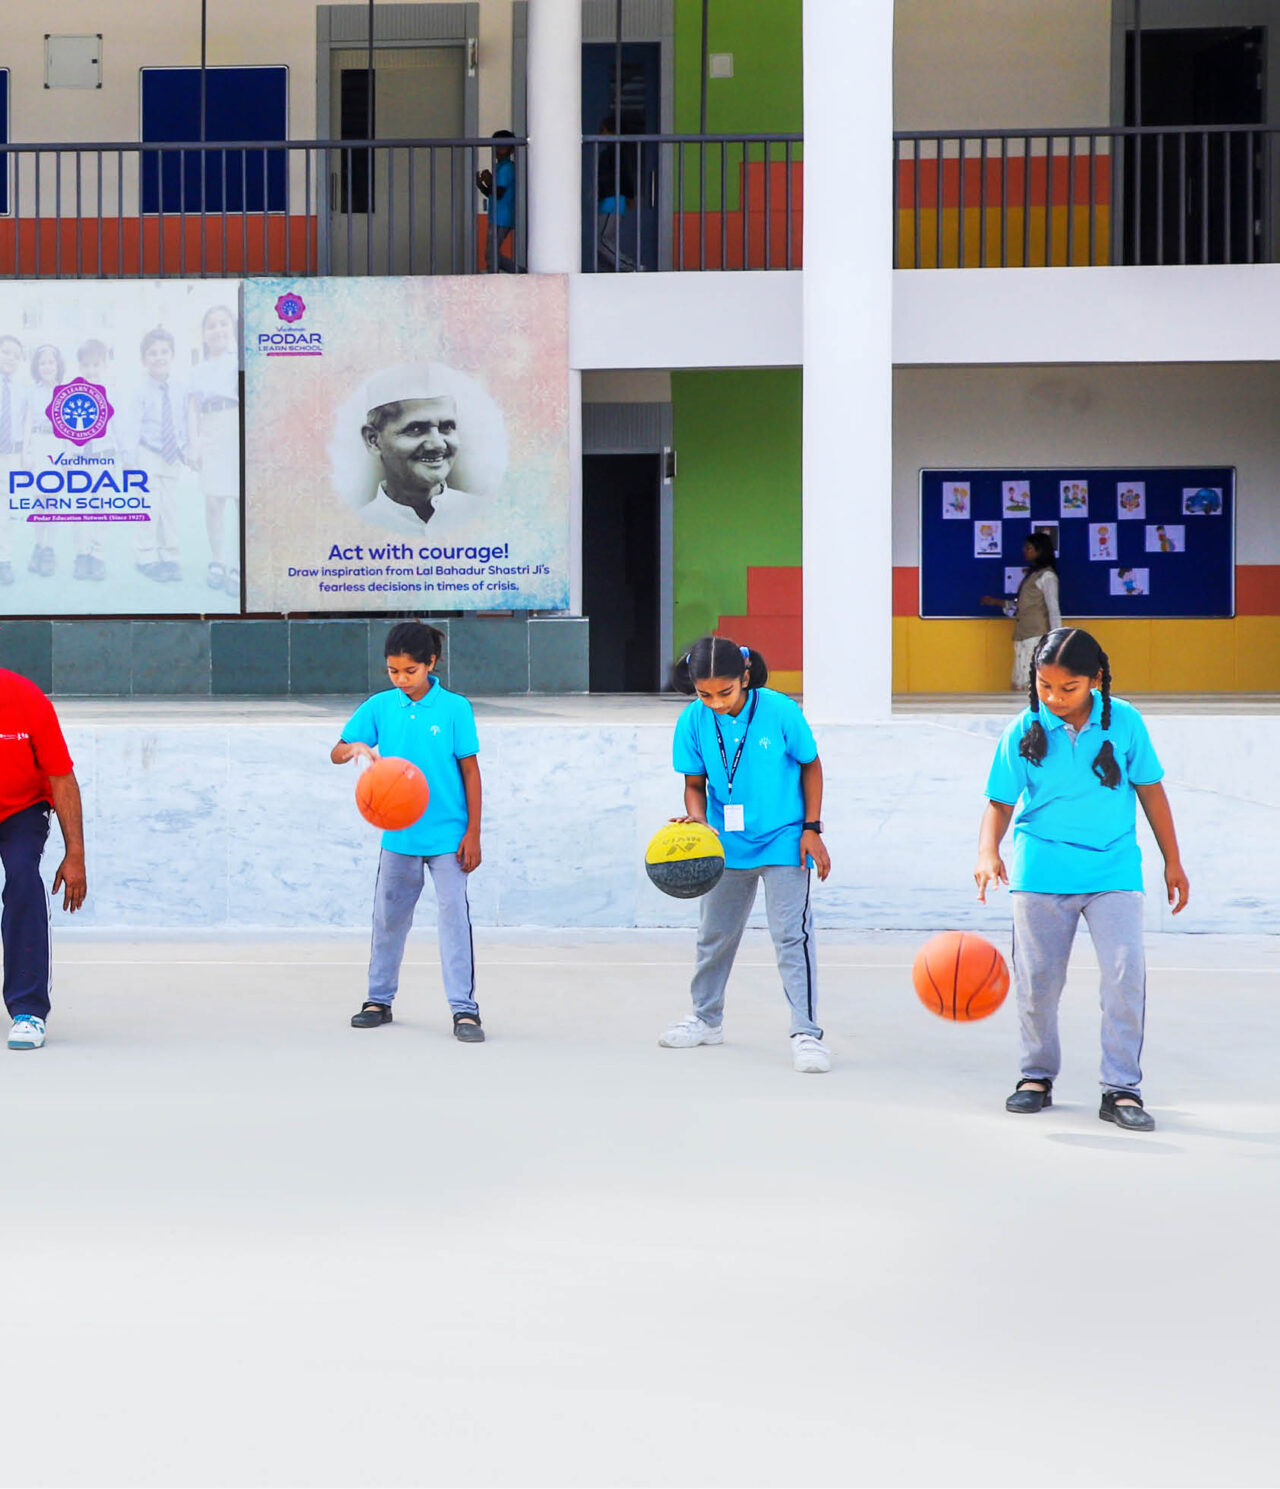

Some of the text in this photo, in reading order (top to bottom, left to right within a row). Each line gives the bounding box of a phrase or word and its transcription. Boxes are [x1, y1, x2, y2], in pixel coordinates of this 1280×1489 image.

[258, 334, 322, 344] PODAR
[67, 386, 88, 394] LEARN
[48, 452, 114, 465] Vardhman
[9, 470, 150, 494] PODAR
[10, 498, 150, 510] LEARN SCHOOL
[328, 543, 508, 563] Act with courage!
[288, 568, 319, 576] Draw
[322, 567, 383, 578] inspiration
[386, 566, 414, 576] from
[416, 566, 433, 576] Lal
[436, 566, 486, 575] Bahadur
[488, 566, 530, 574] Shastri
[319, 581, 519, 592] fearless decisions in times of crisis.
